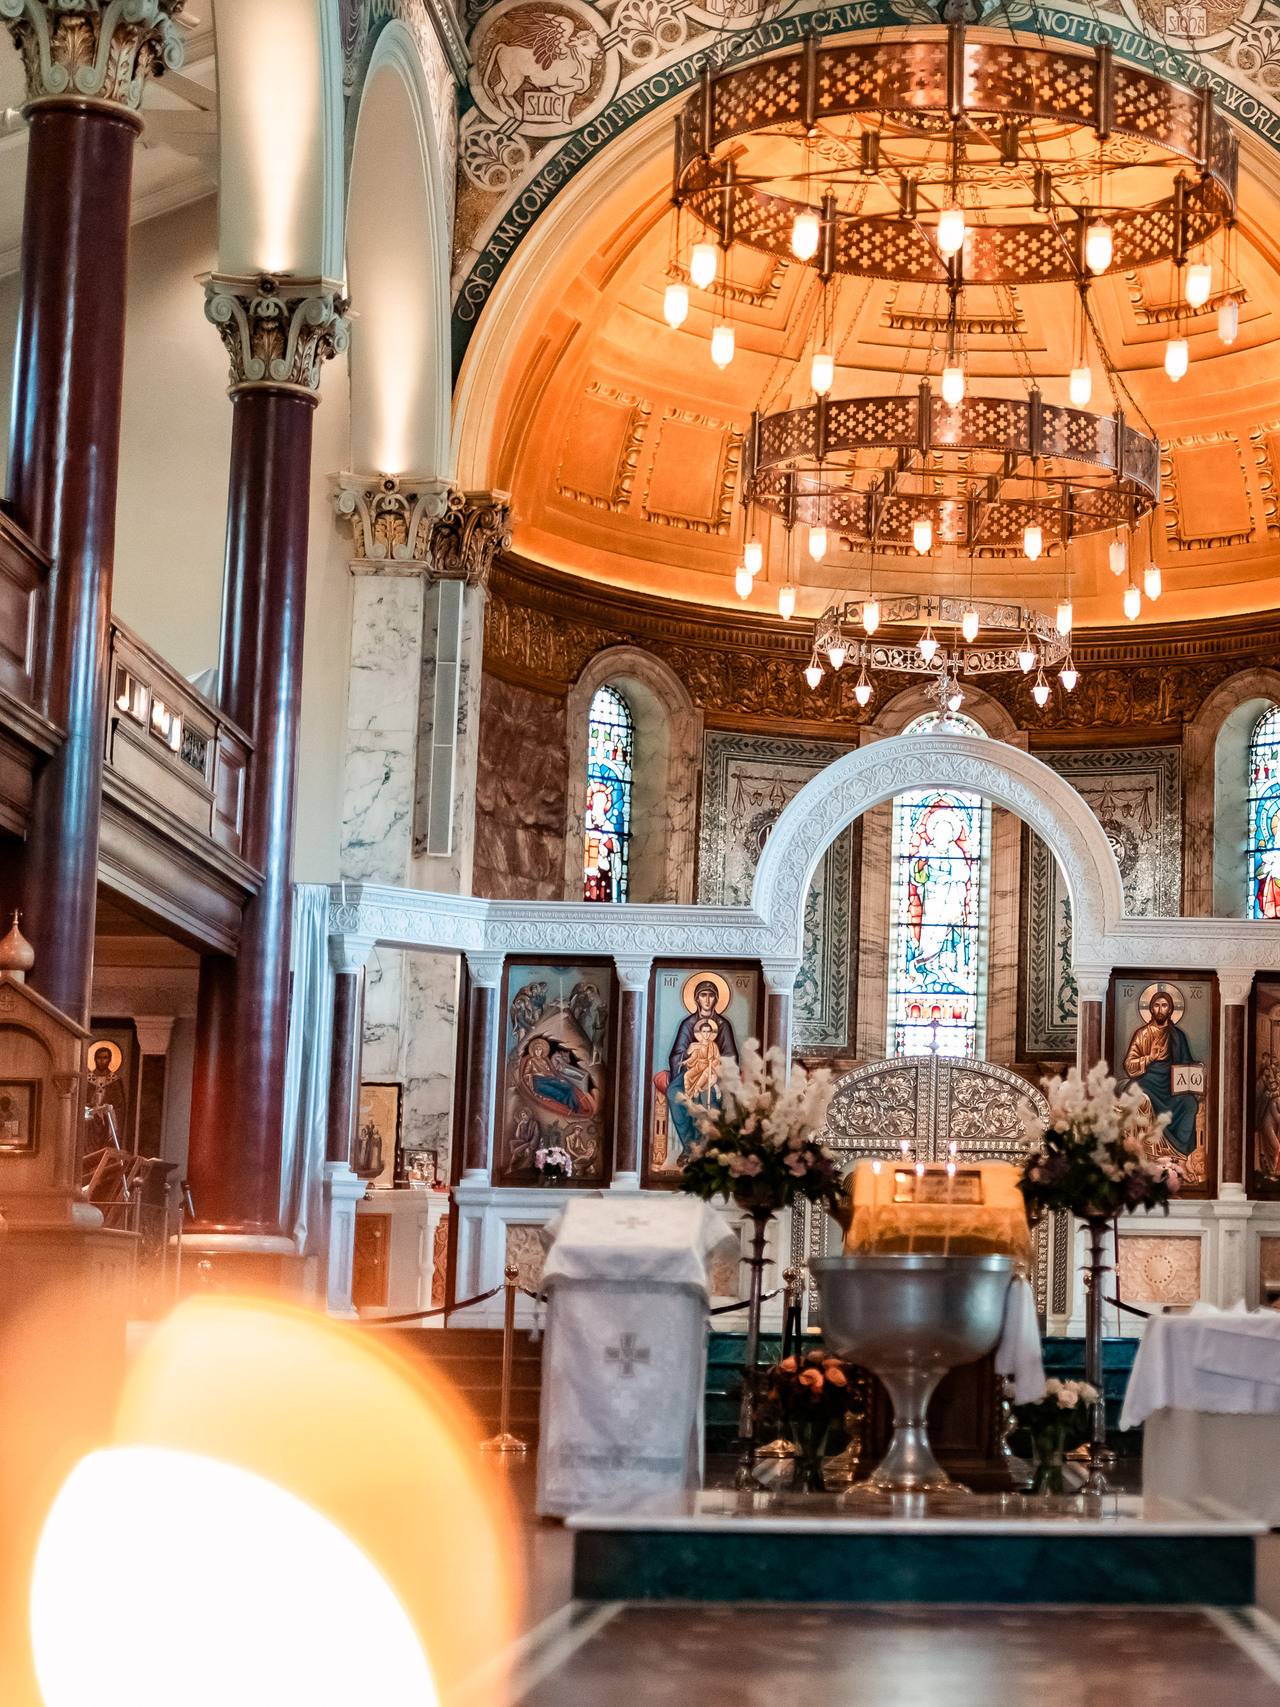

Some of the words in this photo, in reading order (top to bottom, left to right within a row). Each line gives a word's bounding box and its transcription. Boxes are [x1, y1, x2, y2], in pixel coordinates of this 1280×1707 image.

[486, 221, 523, 263] AM
[512, 166, 562, 224] COME
[555, 152, 576, 175] A
[572, 106, 622, 162] LIGHT
[617, 76, 670, 119] INTO
[704, 22, 784, 67] WORLD
[811, 2, 878, 32] CAME
[1037, 9, 1079, 37] NOT
[1083, 19, 1113, 45] TO
[1112, 31, 1182, 75] JUDGE
